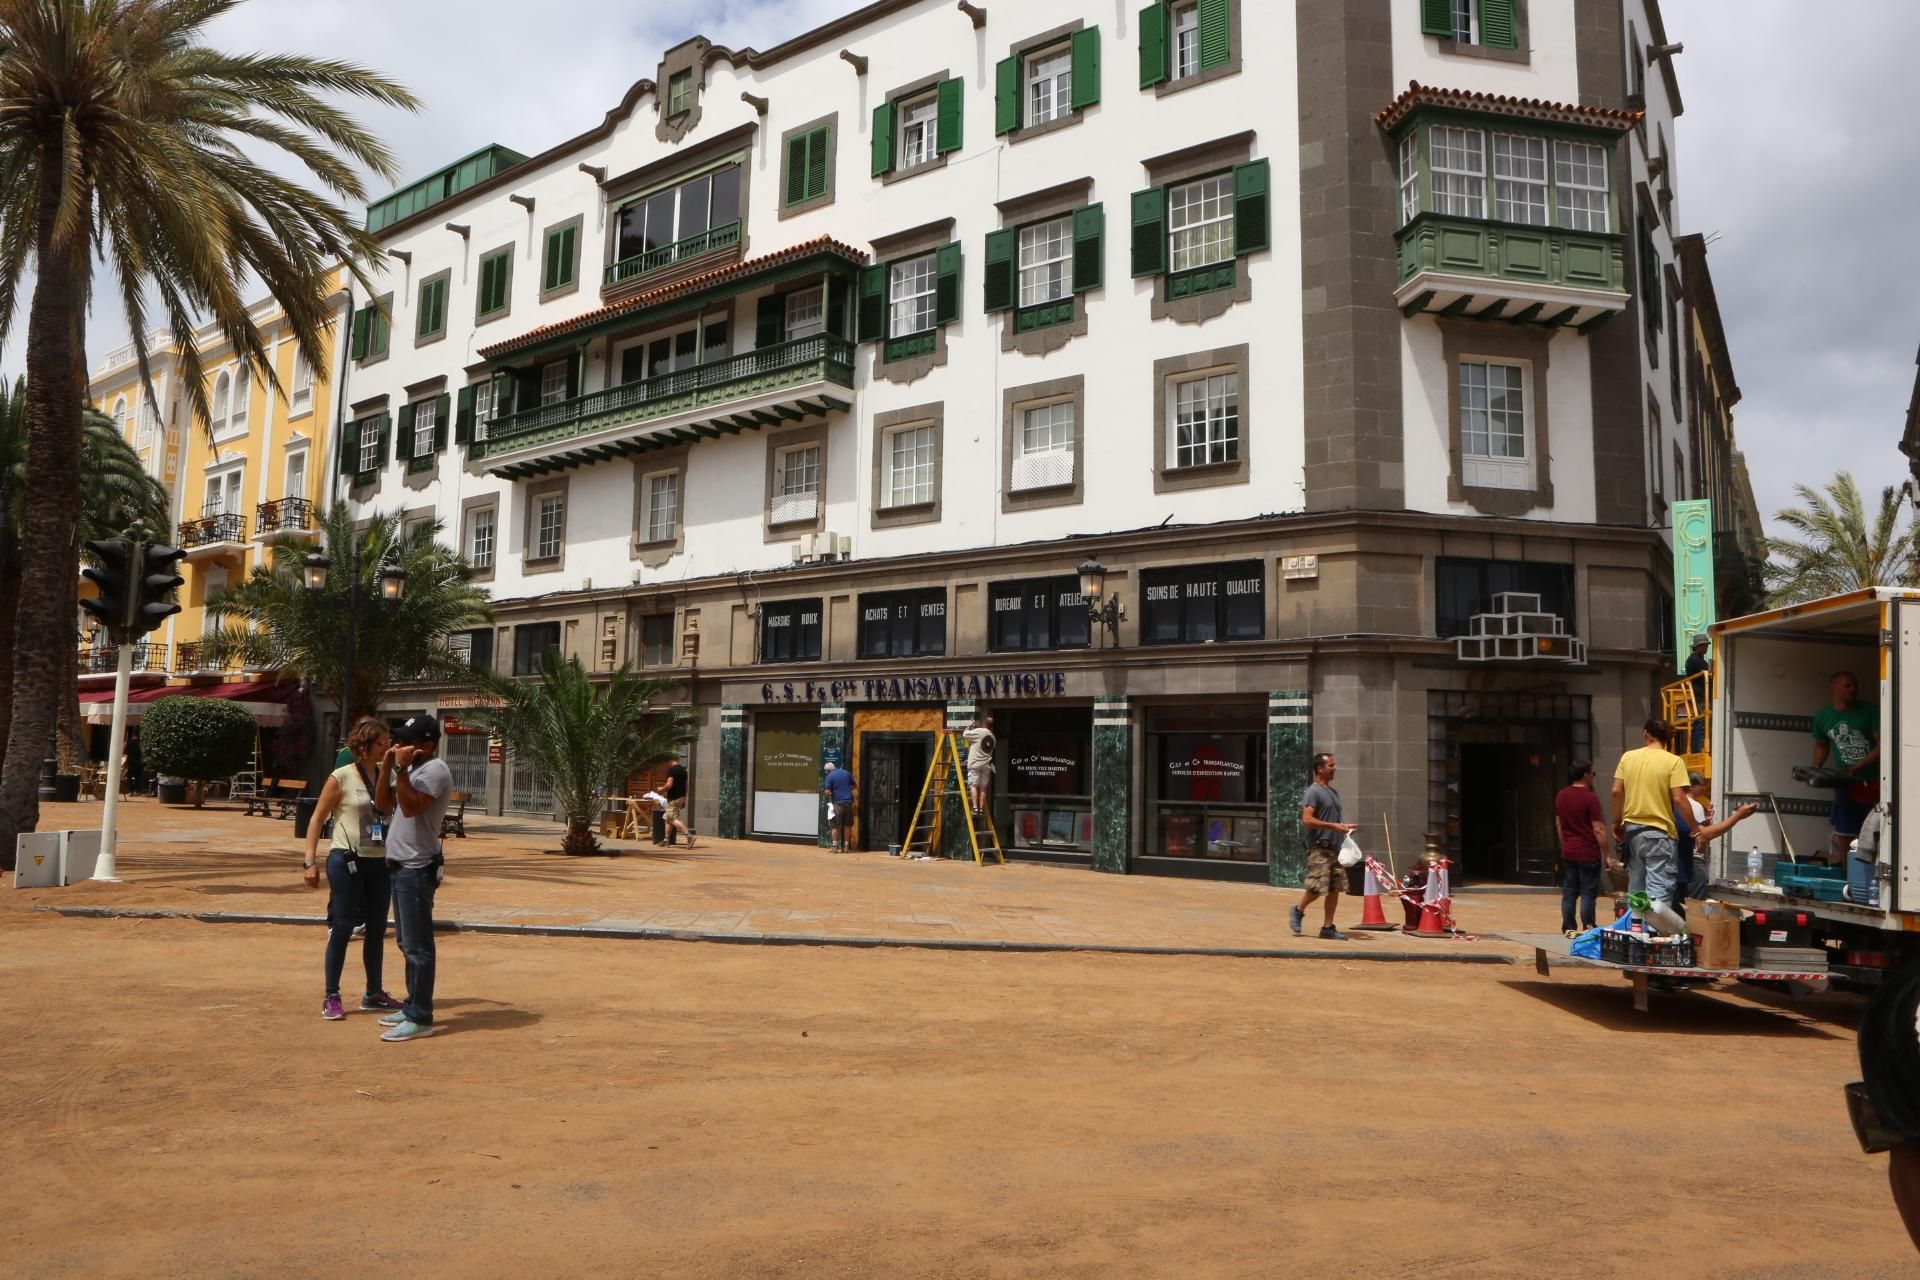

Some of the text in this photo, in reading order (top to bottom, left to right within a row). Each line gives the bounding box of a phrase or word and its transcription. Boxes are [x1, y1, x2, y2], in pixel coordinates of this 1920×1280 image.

[1147, 579, 1260, 600] SOINS DE HAUTE QUALITE
[995, 597, 1022, 611] BUREAUX
[1034, 595, 1045, 608] ET
[801, 612, 818, 625] ROUX
[865, 603, 944, 620] ACHATS ET VENTES
[863, 673, 1065, 698] TRANSATLANTIQUE
[440, 696, 463, 707] HOTEL
[1203, 759, 1244, 770] TRANSATLANTIQUE
